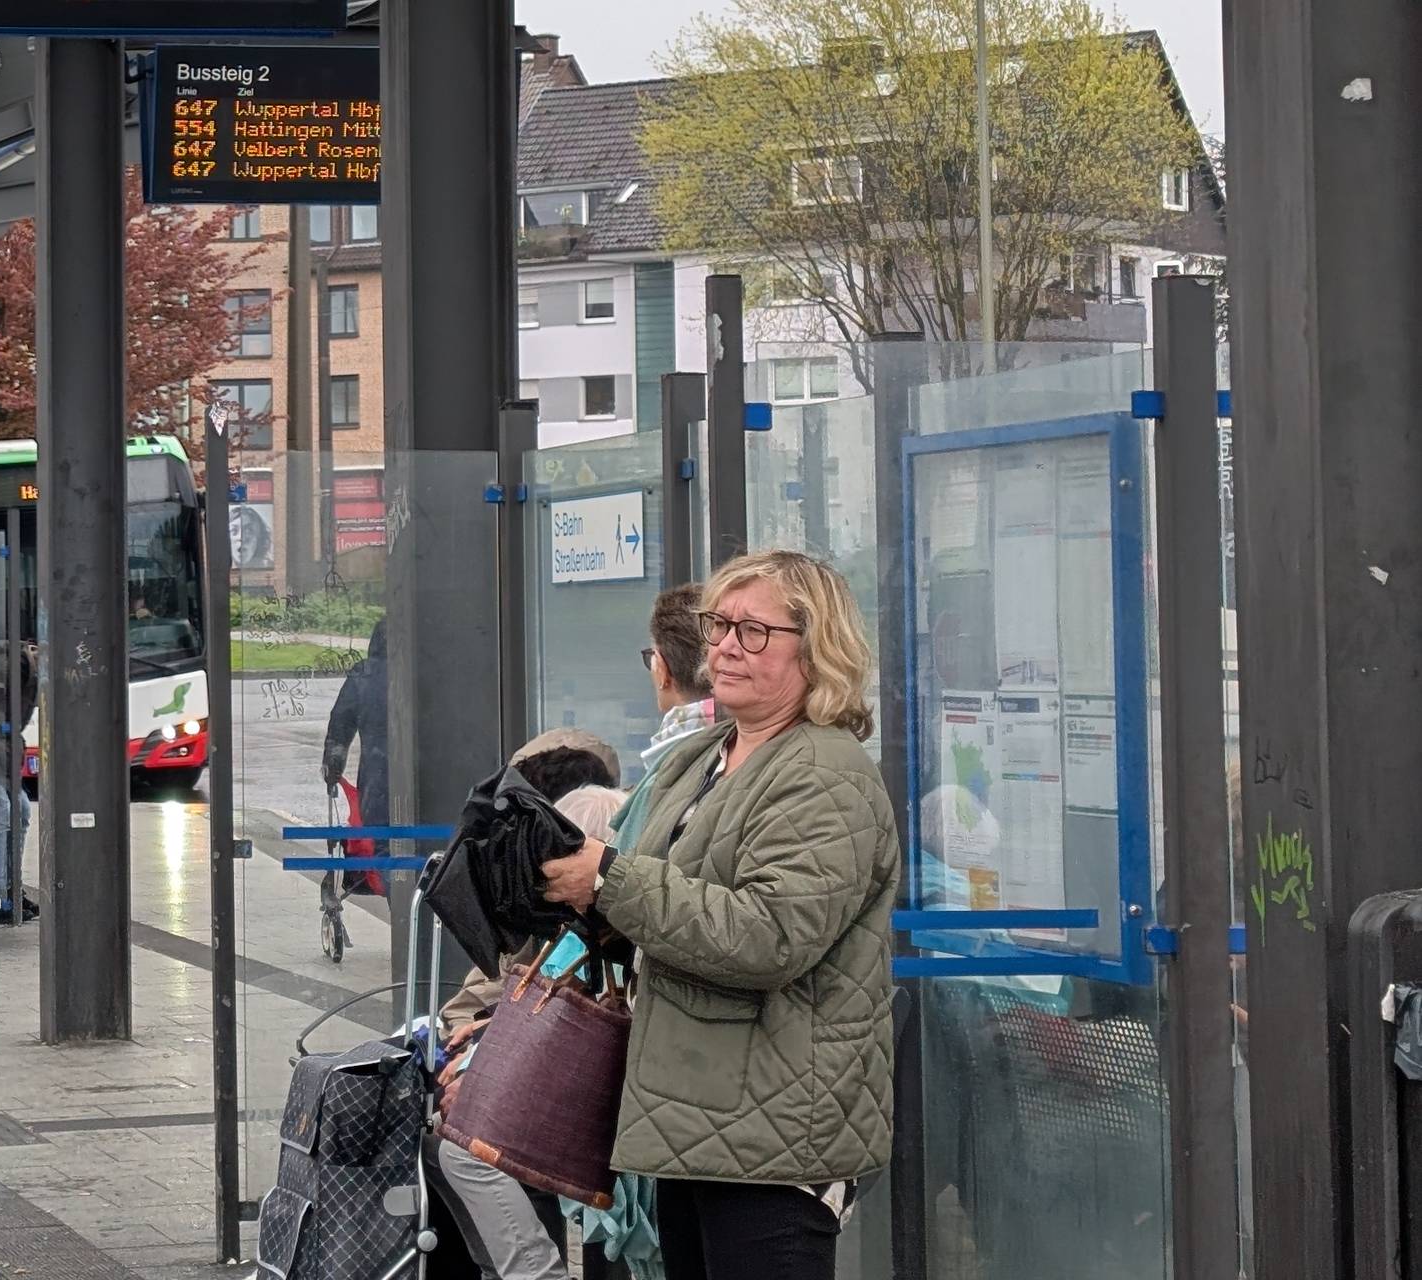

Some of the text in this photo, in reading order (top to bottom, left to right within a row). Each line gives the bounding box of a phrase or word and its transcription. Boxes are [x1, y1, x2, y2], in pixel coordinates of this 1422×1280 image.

[178, 63, 270, 85] Bussteig 2
[177, 87, 254, 96] Linie Ziel
[175, 99, 381, 121] 647 Wuppertal Hbf
[174, 120, 216, 137] 554
[235, 121, 333, 141] Hattingen
[173, 140, 381, 158] 647 Velbert Rosen
[172, 160, 381, 182] 647 Wuppertal Hbf
[554, 512, 584, 537] S-Bahn
[554, 545, 606, 573] Straßenbahn
